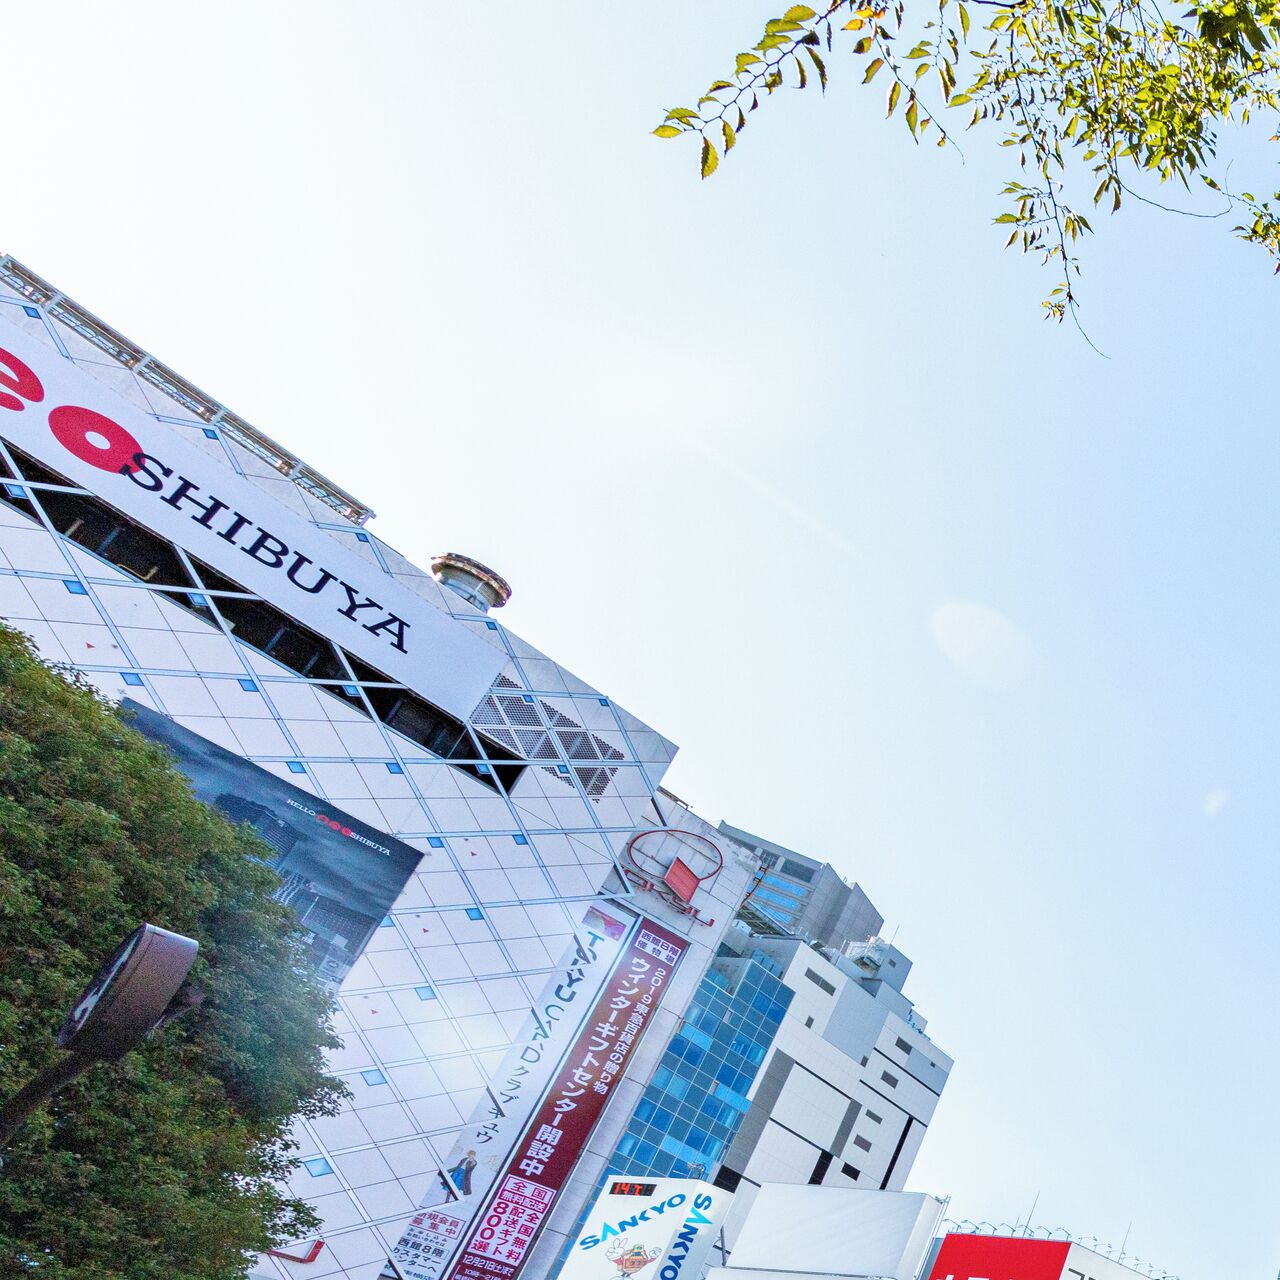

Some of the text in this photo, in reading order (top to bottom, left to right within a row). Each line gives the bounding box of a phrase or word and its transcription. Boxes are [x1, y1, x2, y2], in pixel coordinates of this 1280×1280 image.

[118, 452, 412, 655] SHIBUYA
[286, 798, 317, 817] HELLO
[350, 831, 392, 857] SHIBUYA
[519, 956, 652, 1178] ウィンターギフトセンター開設中
[592, 967, 667, 1096] 2019東急百貨店の贈り物
[510, 1181, 548, 1200] 全国
[579, 1192, 687, 1250] SANKYO
